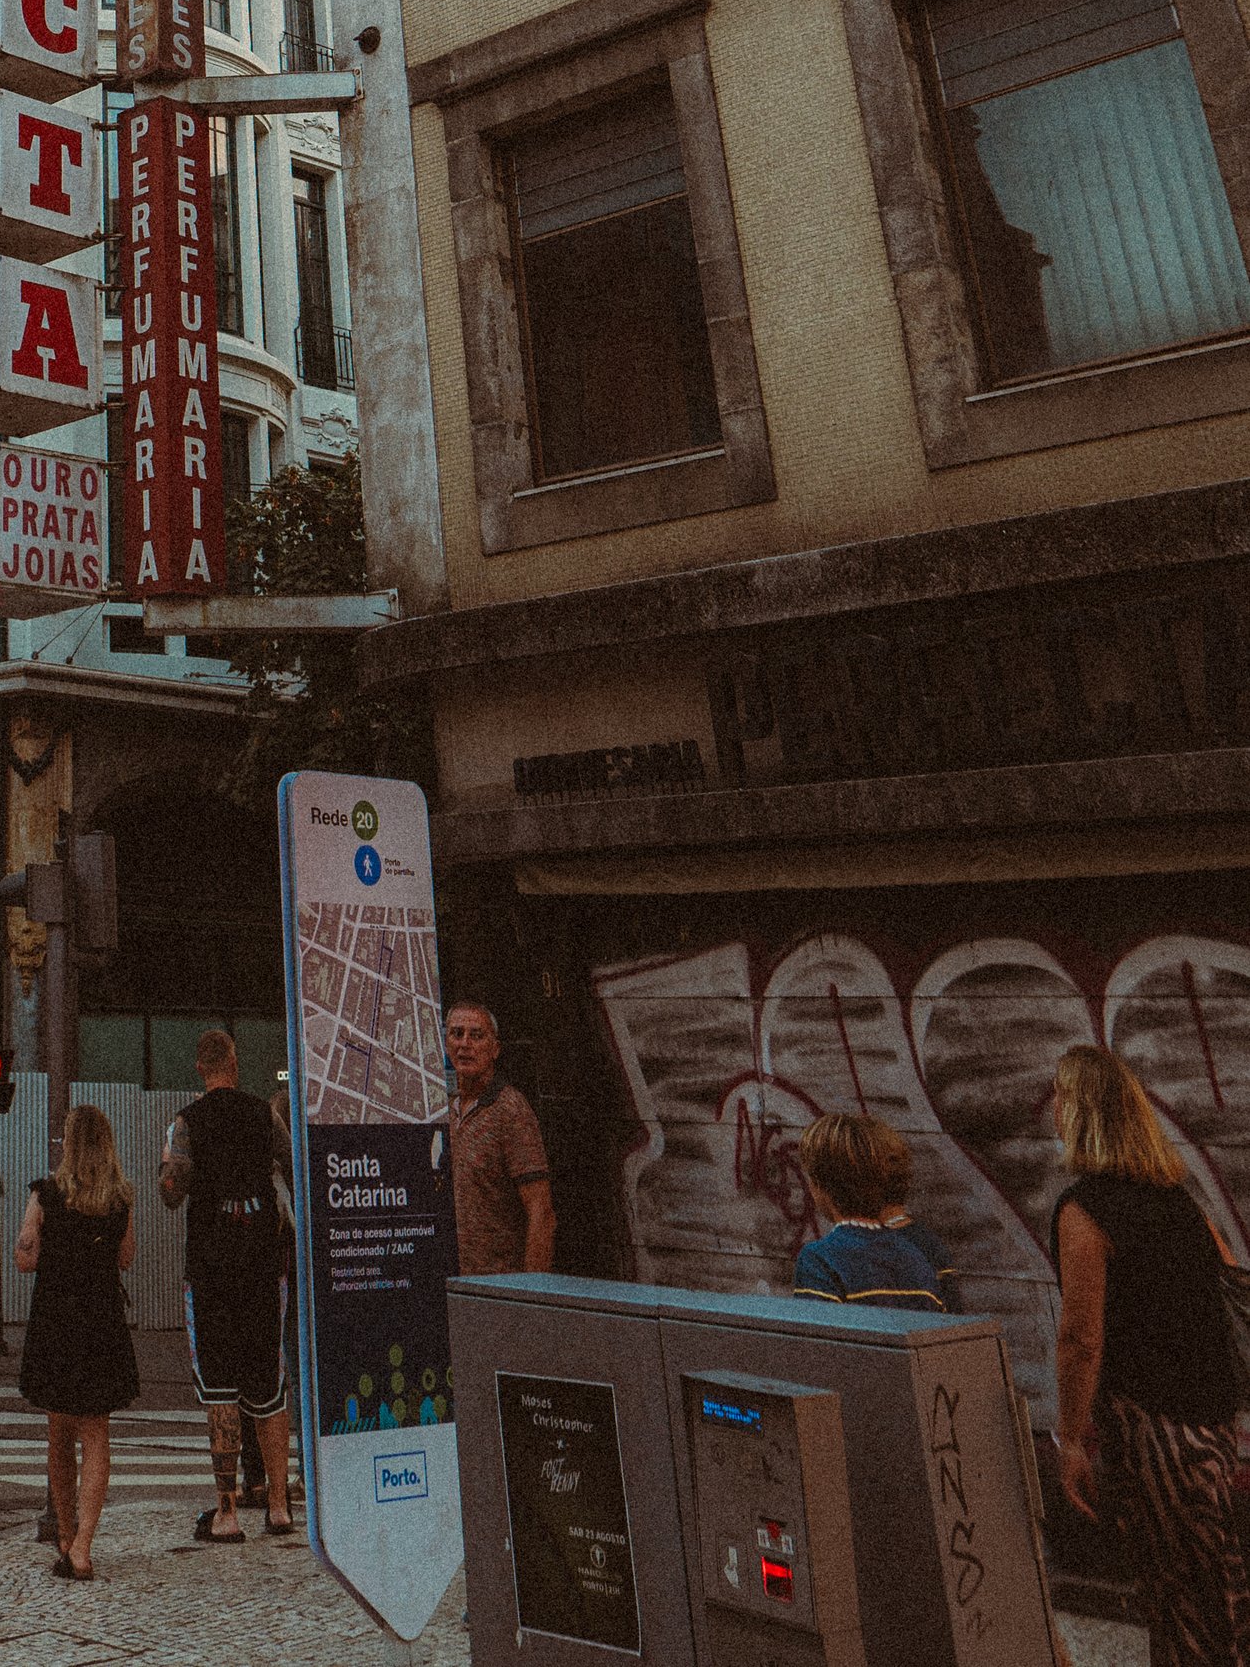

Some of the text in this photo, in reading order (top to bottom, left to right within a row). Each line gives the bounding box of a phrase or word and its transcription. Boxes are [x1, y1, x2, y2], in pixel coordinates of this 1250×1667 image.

[131, 115, 159, 584] PERFUMARIA
[174, 110, 212, 583] PERFUMARIA
[3, 453, 99, 502] OURO
[2, 496, 100, 546] PRATA
[2, 543, 100, 590] JOIAS
[311, 806, 373, 830] Rede 20
[326, 1153, 381, 1179] Santa
[328, 1182, 408, 1210] Catarina
[329, 1224, 435, 1241] Zona de acesso automóvel
[330, 1244, 385, 1258] condicionado
[391, 1242, 415, 1255] ZAAC
[331, 1266, 383, 1278] Restricted area.
[368, 1279, 395, 1290] vehicles
[395, 1278, 412, 1290] only.
[533, 1412, 594, 1434] Christopher
[381, 1467, 421, 1490] Porto.
[595, 1530, 626, 1546] AGOSTO
